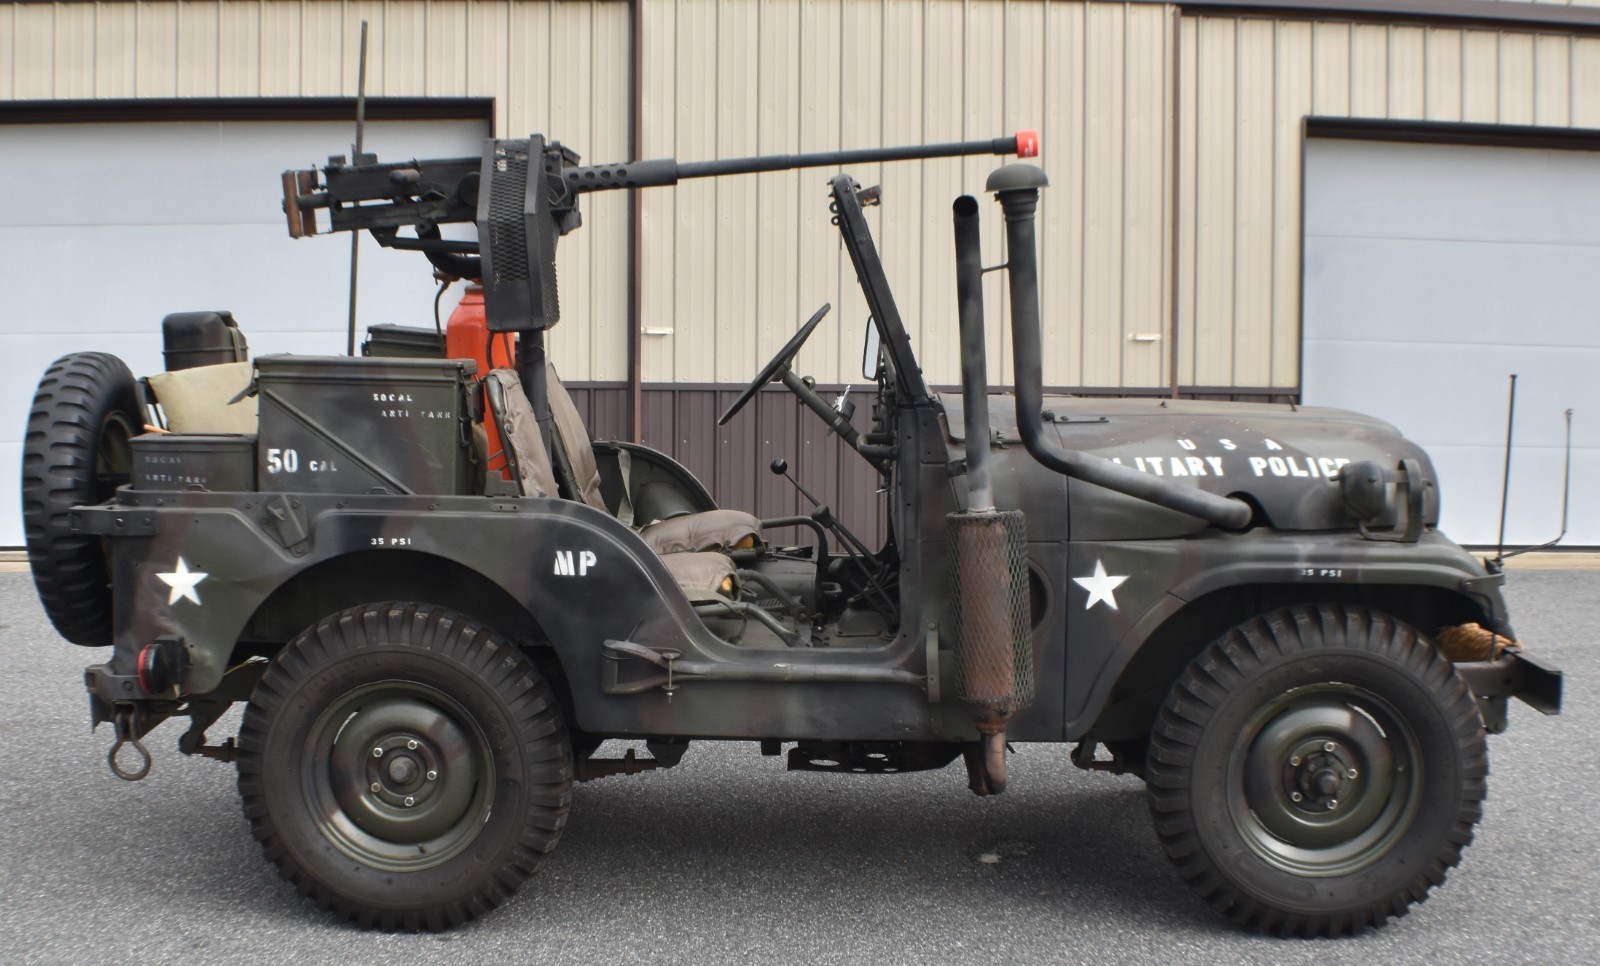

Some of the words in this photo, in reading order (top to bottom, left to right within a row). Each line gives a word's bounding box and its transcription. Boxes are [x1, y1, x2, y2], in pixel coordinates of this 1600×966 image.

[266, 448, 299, 474] 50
[309, 460, 338, 472] CAL
[370, 537, 385, 546] 35
[391, 537, 412, 546] PSI
[553, 550, 598, 577] MP
[1320, 569, 1343, 578] PSI
